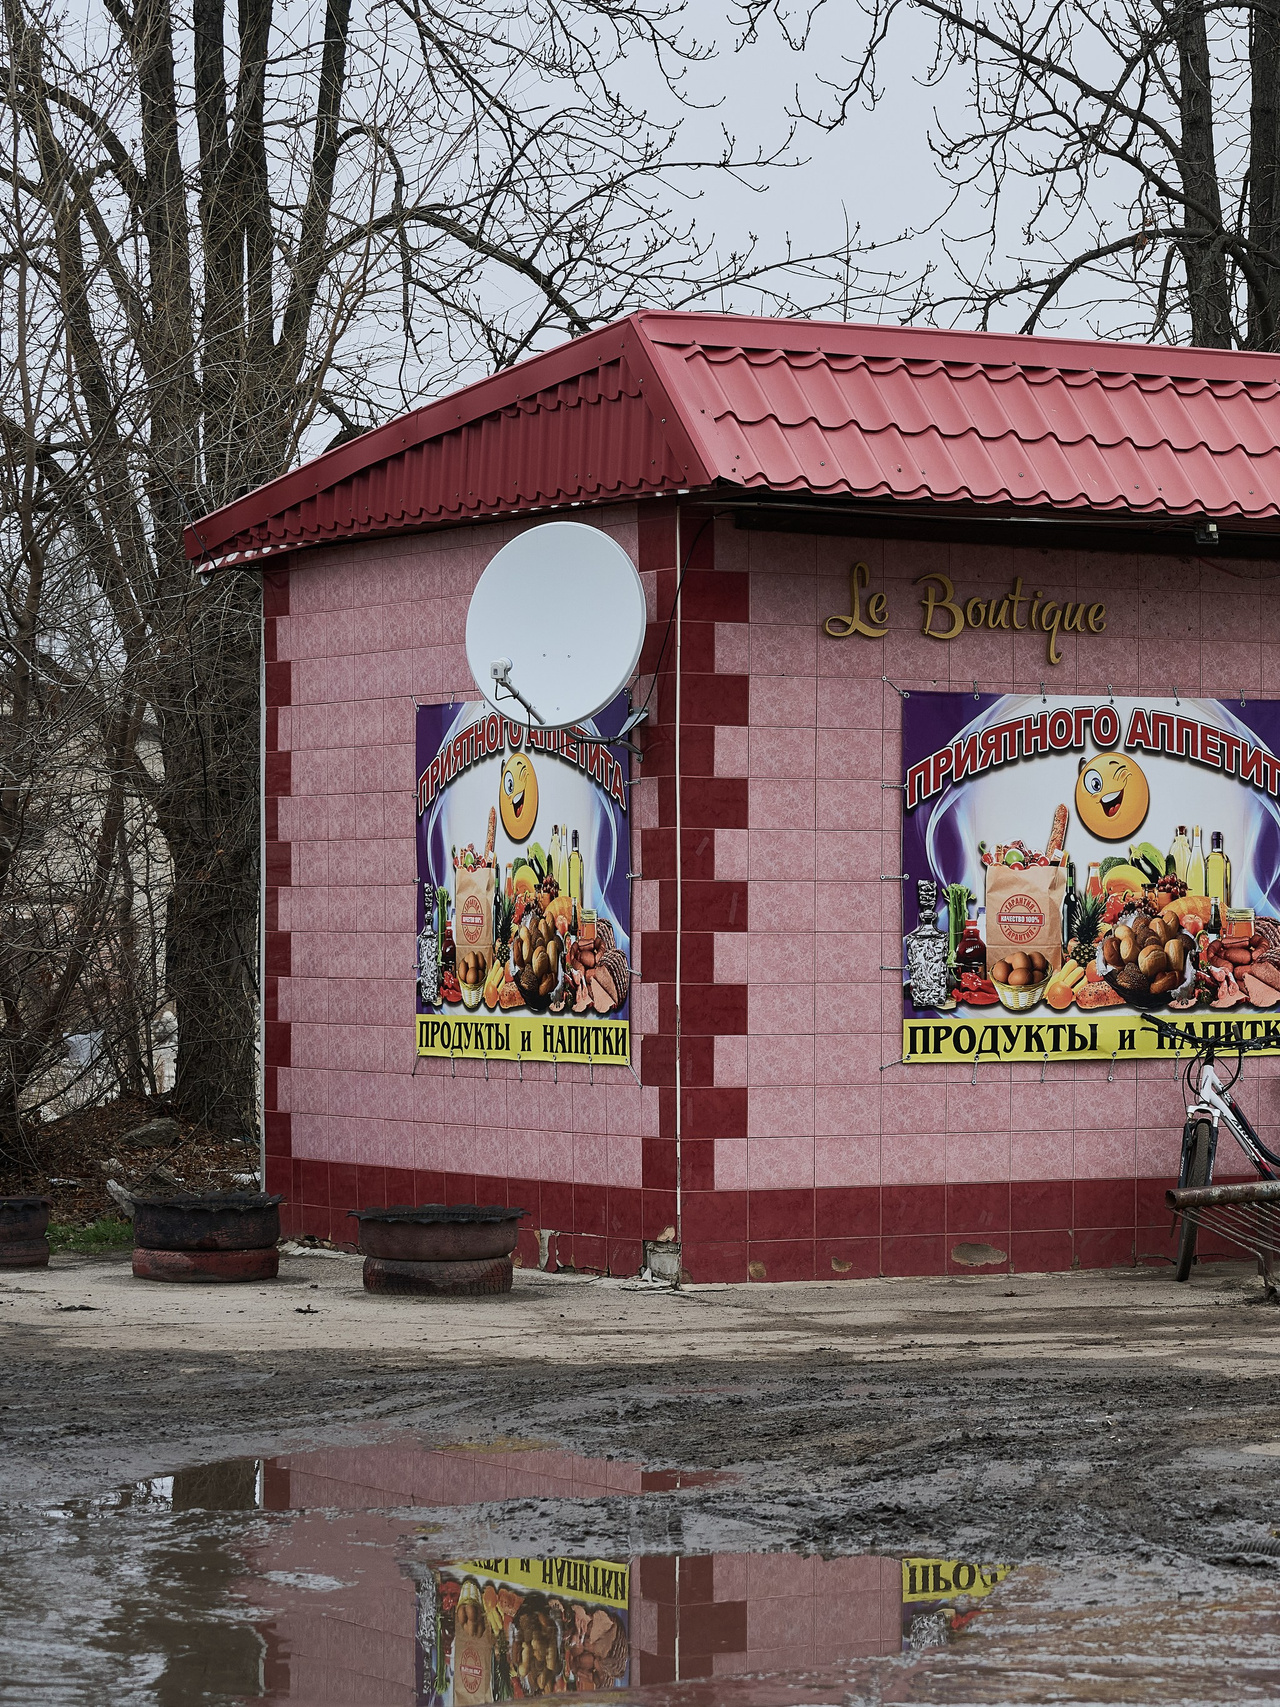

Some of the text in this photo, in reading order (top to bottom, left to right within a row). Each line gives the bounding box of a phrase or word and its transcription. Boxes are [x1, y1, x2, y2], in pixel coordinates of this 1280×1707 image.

[823, 562, 1107, 664] Le Boutique
[906, 704, 1120, 810] ПРИЯТНОГО
[419, 1021, 627, 1056] ПРОДУКТЫ и НАПИТКИ
[908, 1024, 1098, 1060] ПРОДУКТЫ
[1118, 1029, 1136, 1050] и
